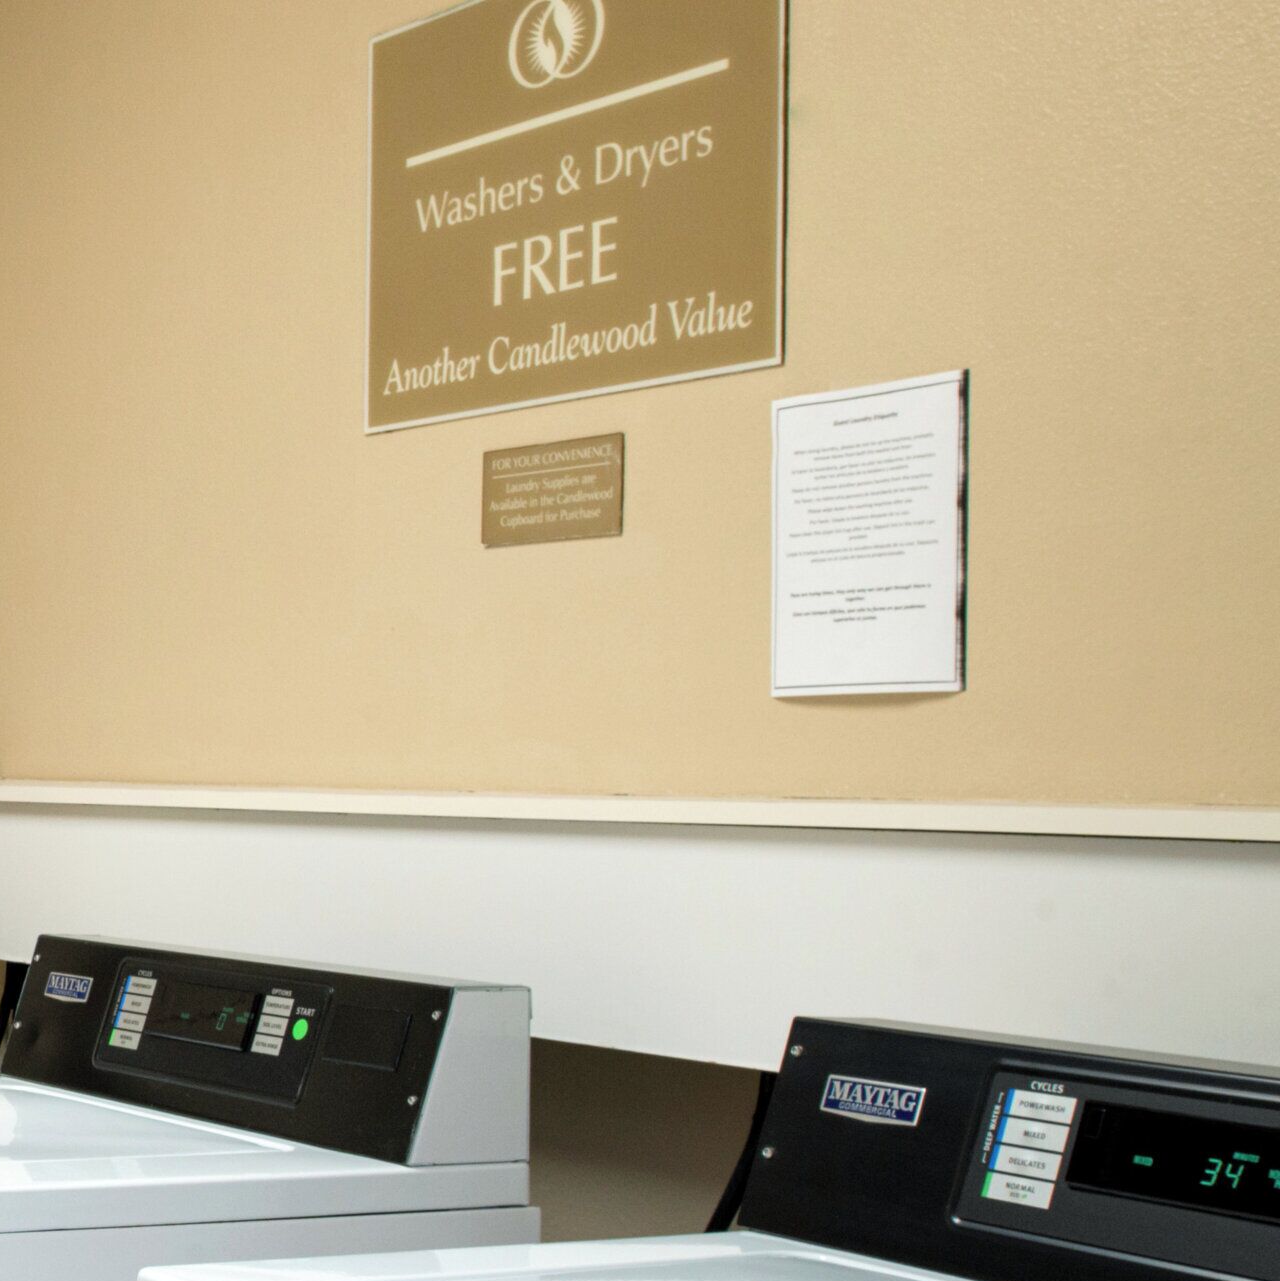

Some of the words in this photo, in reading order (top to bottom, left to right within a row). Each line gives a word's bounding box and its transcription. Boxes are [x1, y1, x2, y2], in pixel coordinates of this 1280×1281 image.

[416, 173, 543, 232] Washers
[556, 154, 580, 196] &
[595, 125, 713, 188] Dryers
[492, 216, 618, 306] FREE
[383, 347, 480, 396] Another
[488, 304, 656, 374] Candlewood
[667, 291, 753, 340] Value
[492, 457, 511, 470] FOR
[513, 454, 540, 468] YOUR
[542, 444, 612, 464] CONVENIENCE
[506, 479, 539, 494] Laundry
[542, 475, 580, 490] Supplies
[489, 497, 527, 511] Available
[529, 496, 538, 507] in
[541, 495, 554, 507] the
[557, 487, 613, 505] Candlewood
[500, 512, 543, 529] Cupboard
[545, 511, 557, 523] for
[560, 507, 601, 521] Purchase
[48, 975, 88, 993] MAYTAG
[271, 988, 292, 997] OPTIONS
[296, 1007, 315, 1016] START
[828, 1080, 916, 1113] MAYTAG
[1031, 1081, 1064, 1093] CYCLES
[838, 1101, 897, 1118] COMMERCIAL
[1019, 1100, 1065, 1113] POWERWASH
[983, 1132, 993, 1151] DEEP
[989, 1105, 1001, 1131] WATER
[1022, 1130, 1046, 1140] MIXED
[1008, 1156, 1046, 1169] DELICATES
[1199, 1157, 1245, 1190] 34
[1005, 1181, 1036, 1194] NORMAL
